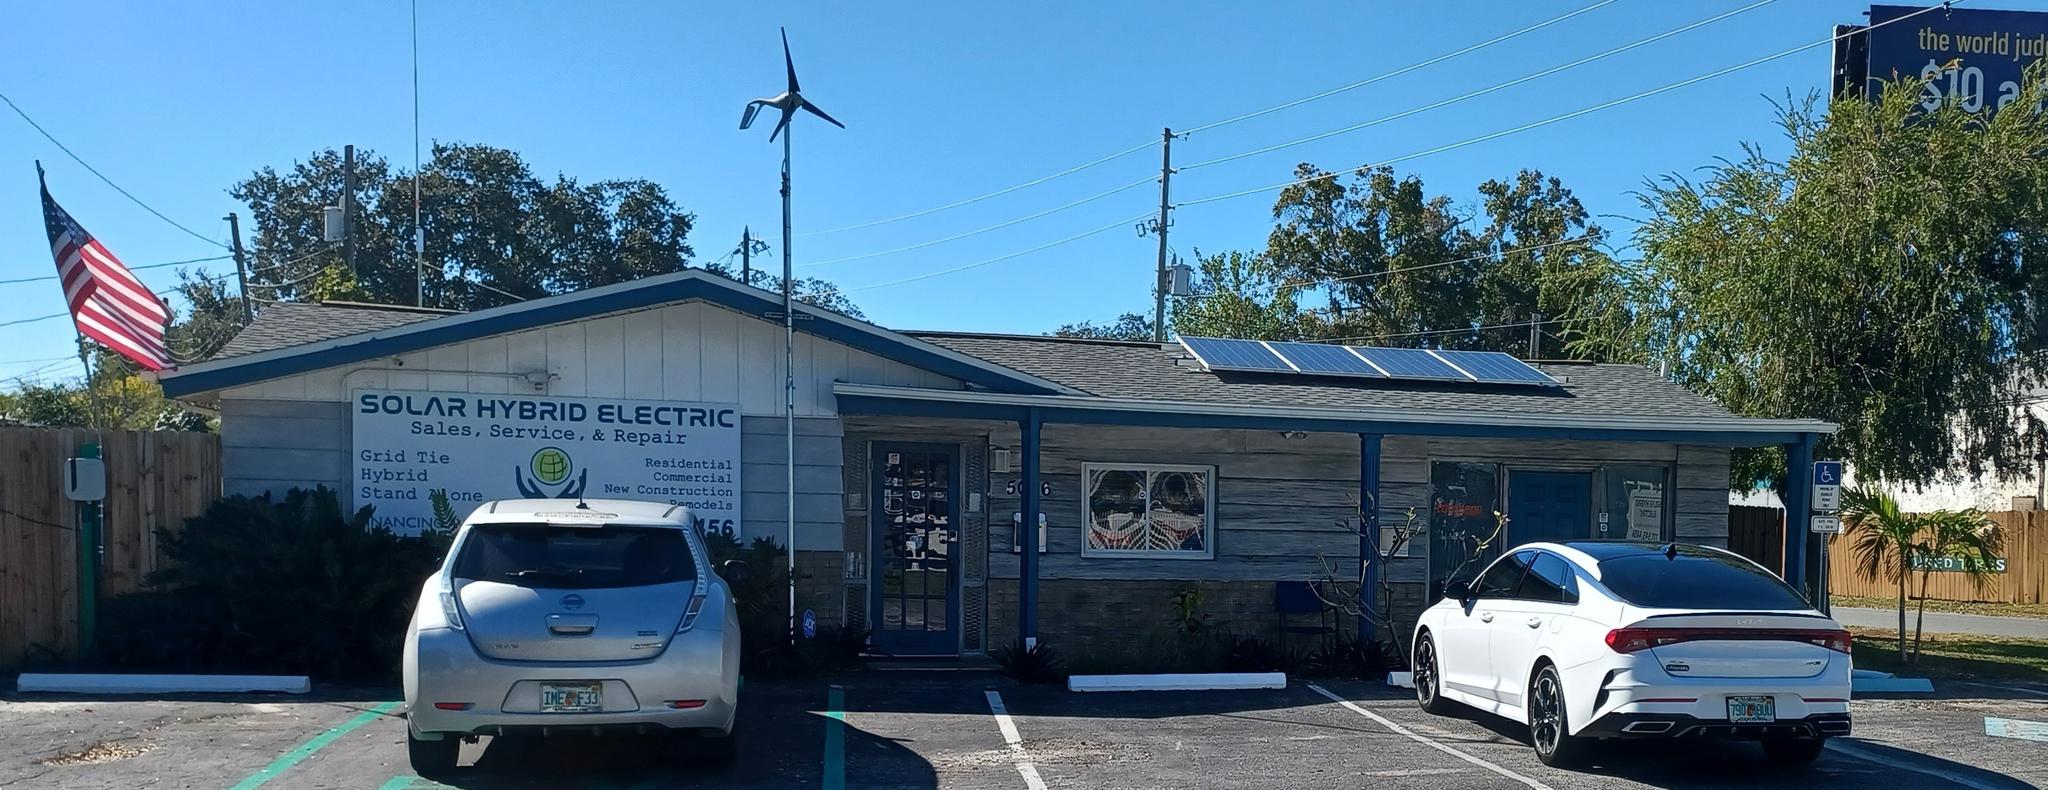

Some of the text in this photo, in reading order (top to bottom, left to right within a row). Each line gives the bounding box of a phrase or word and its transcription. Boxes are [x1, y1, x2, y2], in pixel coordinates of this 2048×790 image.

[1918, 27, 2048, 61] the world jud
[1921, 59, 1984, 113] $10
[361, 394, 734, 428] SOLAR HYBRID ELECTRIC
[411, 421, 687, 446] Sales, Service, & Repair
[361, 449, 450, 463] Grid Tie
[645, 458, 733, 470] Residential
[361, 468, 428, 483] Hybrid
[653, 472, 733, 483] Commercial
[361, 487, 483, 501] Stand Aone
[604, 484, 733, 497] New Construction
[1006, 480, 1051, 496] 56
